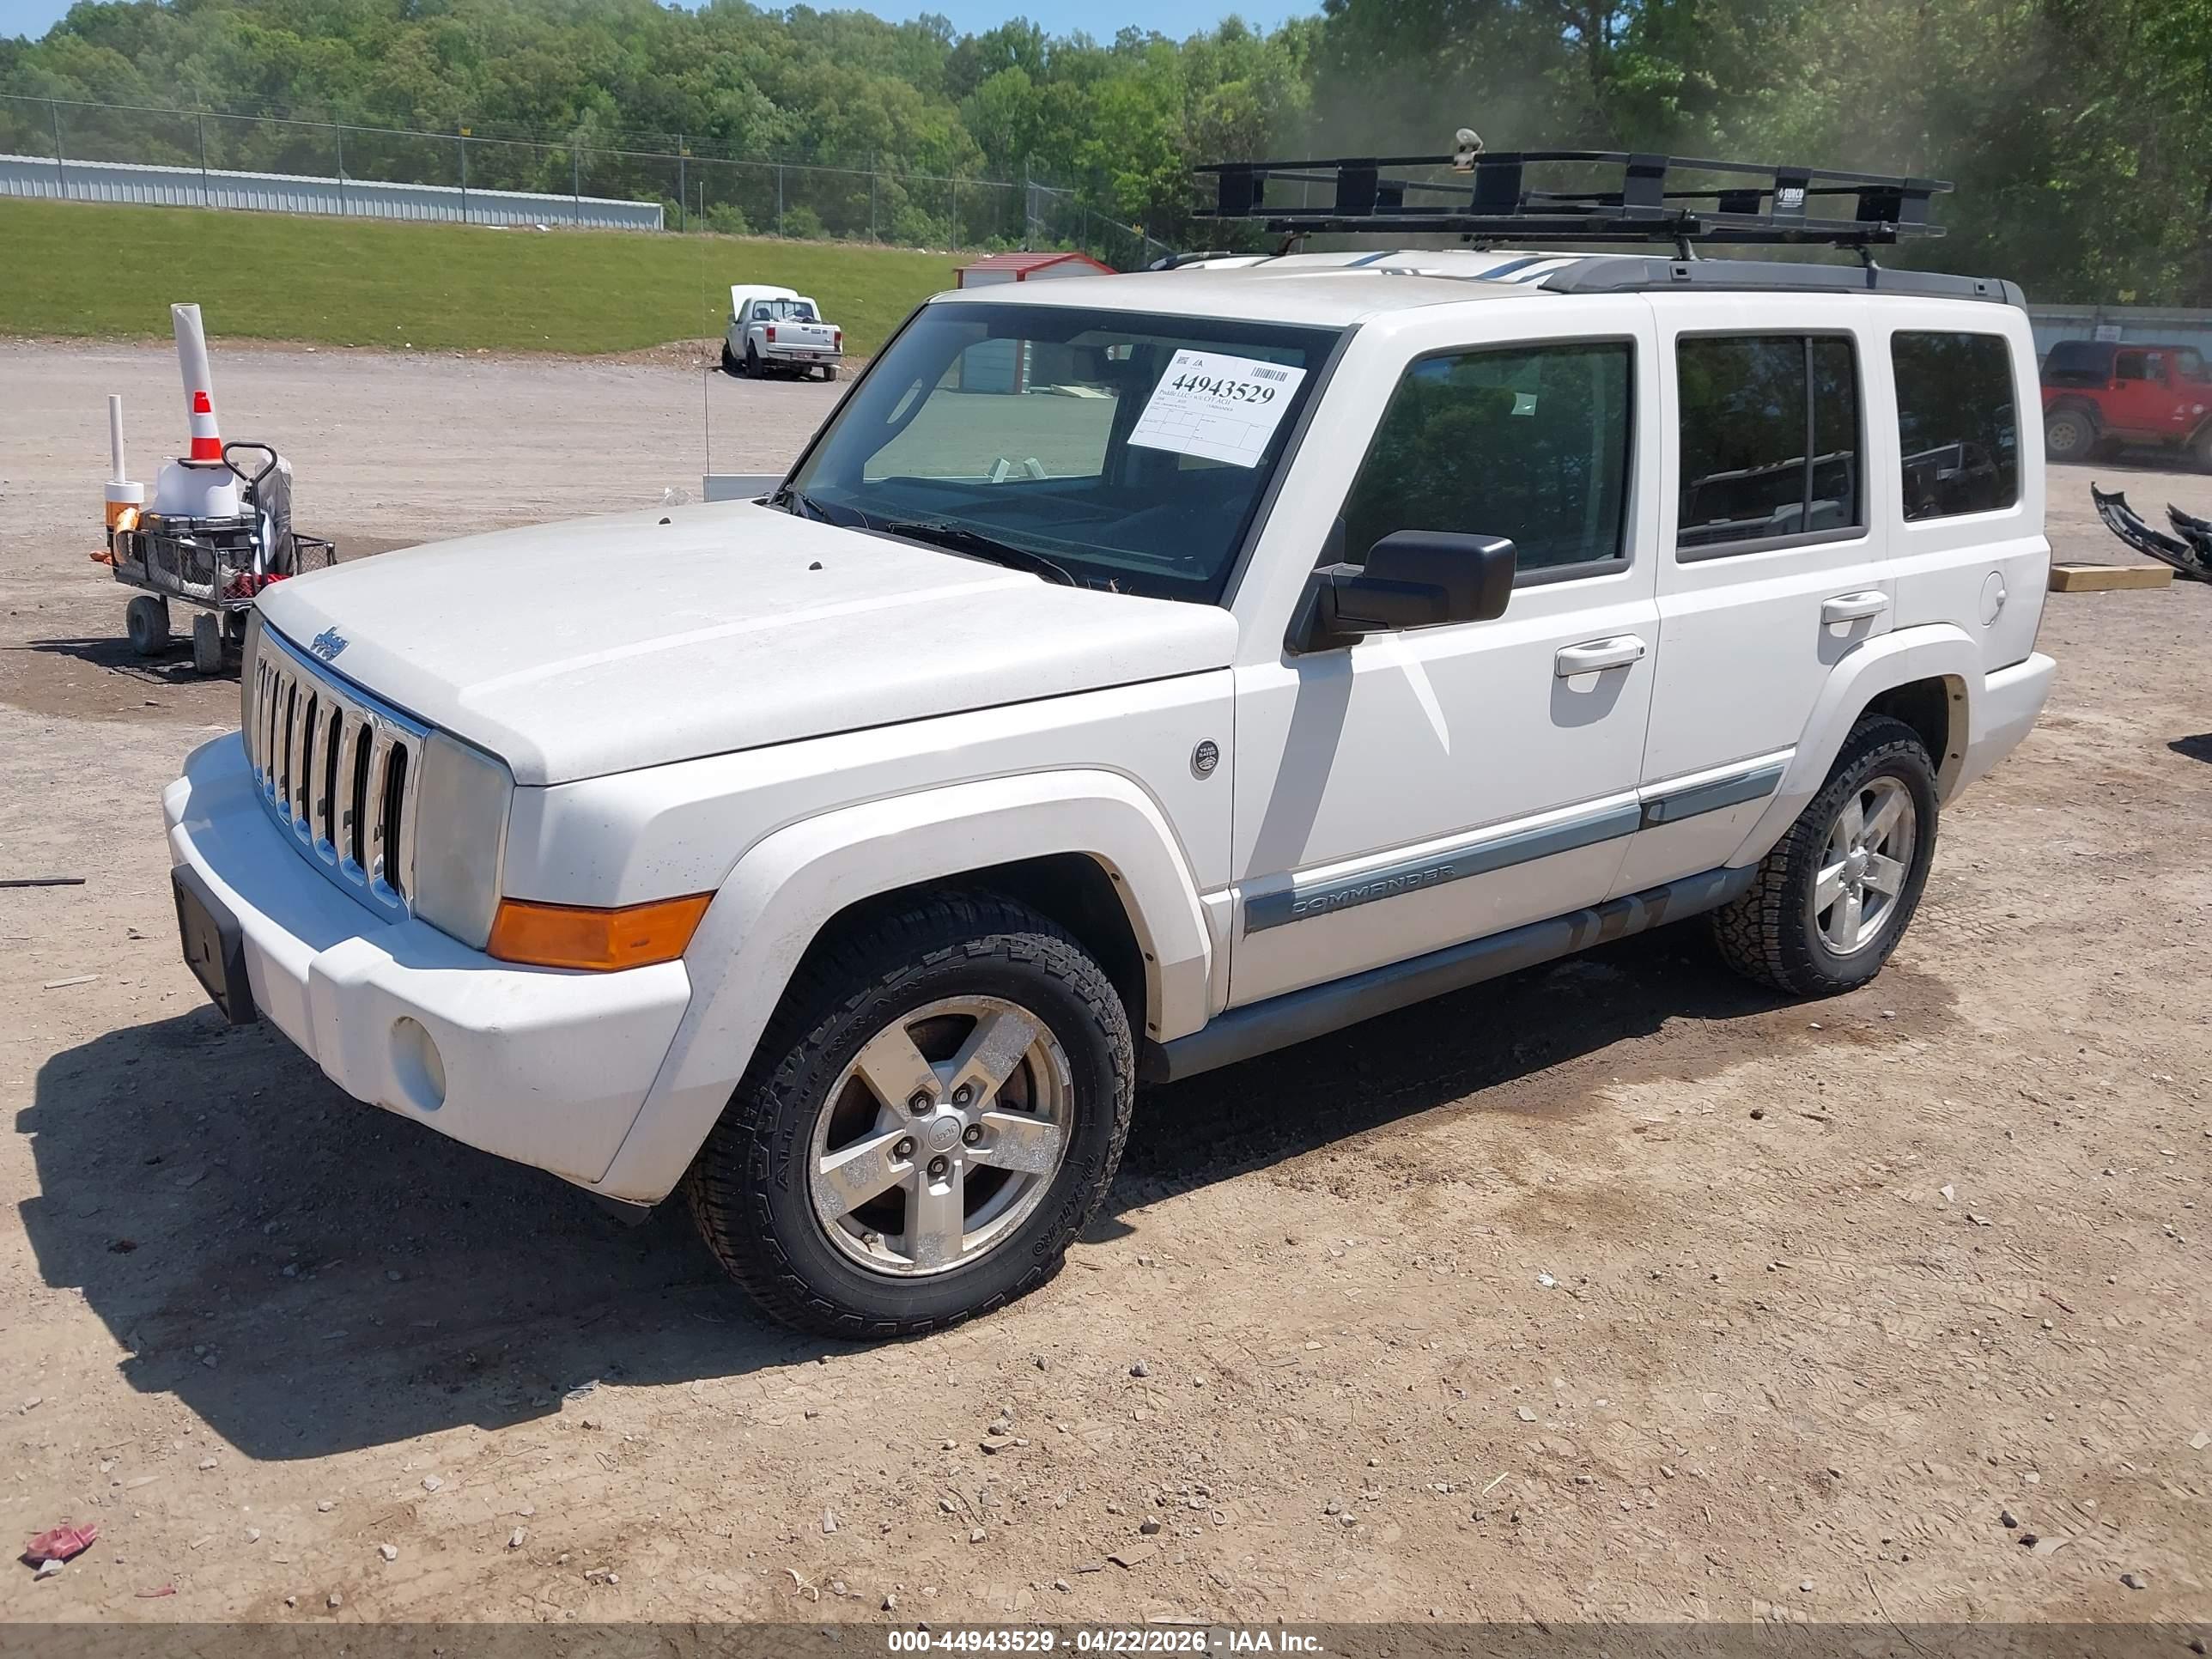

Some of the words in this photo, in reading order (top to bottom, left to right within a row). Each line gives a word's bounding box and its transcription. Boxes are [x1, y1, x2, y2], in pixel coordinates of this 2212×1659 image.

[1784, 187, 1804, 199] SURCO
[1171, 373, 1276, 405] 44943529
[1291, 864, 1457, 915] COMMANDER
